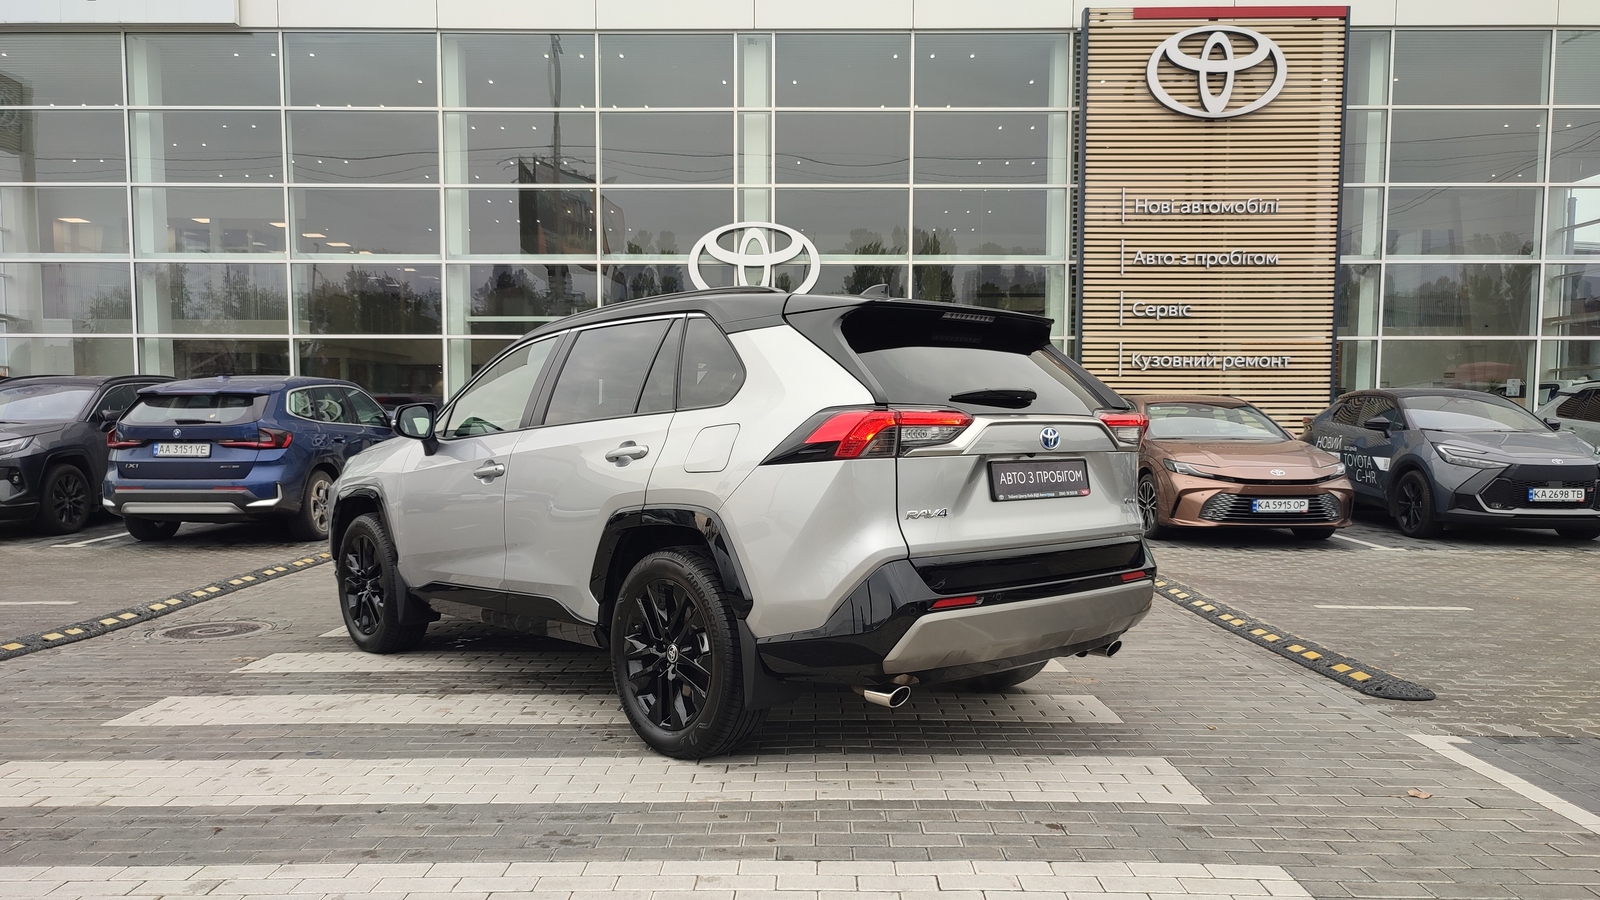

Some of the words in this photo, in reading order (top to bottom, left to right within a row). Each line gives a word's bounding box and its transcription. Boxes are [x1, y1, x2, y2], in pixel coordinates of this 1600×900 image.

[1135, 199, 1174, 214] Нові
[1180, 198, 1280, 214] автомобілі
[1133, 250, 1175, 265] Авто
[1179, 253, 1189, 265] з
[1194, 249, 1279, 269] пробігом
[1132, 302, 1192, 320] Сервіс
[1131, 352, 1217, 371] Кузовний
[1222, 356, 1291, 371] ремонт
[158, 445, 171, 454] AA
[173, 445, 193, 454] 3151
[195, 445, 207, 454] YE
[1316, 435, 1342, 449] НОВИЙ
[1344, 453, 1373, 469] TOYOTA
[1000, 471, 1026, 485] АВТО
[1027, 471, 1035, 484] З
[1036, 470, 1083, 484] ПРОБІГОМ
[1356, 469, 1377, 484] C-HR
[1533, 490, 1547, 498] KA
[1548, 490, 1569, 498] 2698
[1571, 490, 1583, 498] TB
[1257, 501, 1270, 509] KA
[1272, 501, 1292, 509] 5915
[1293, 501, 1306, 509] OP
[905, 508, 948, 520] RAV4
